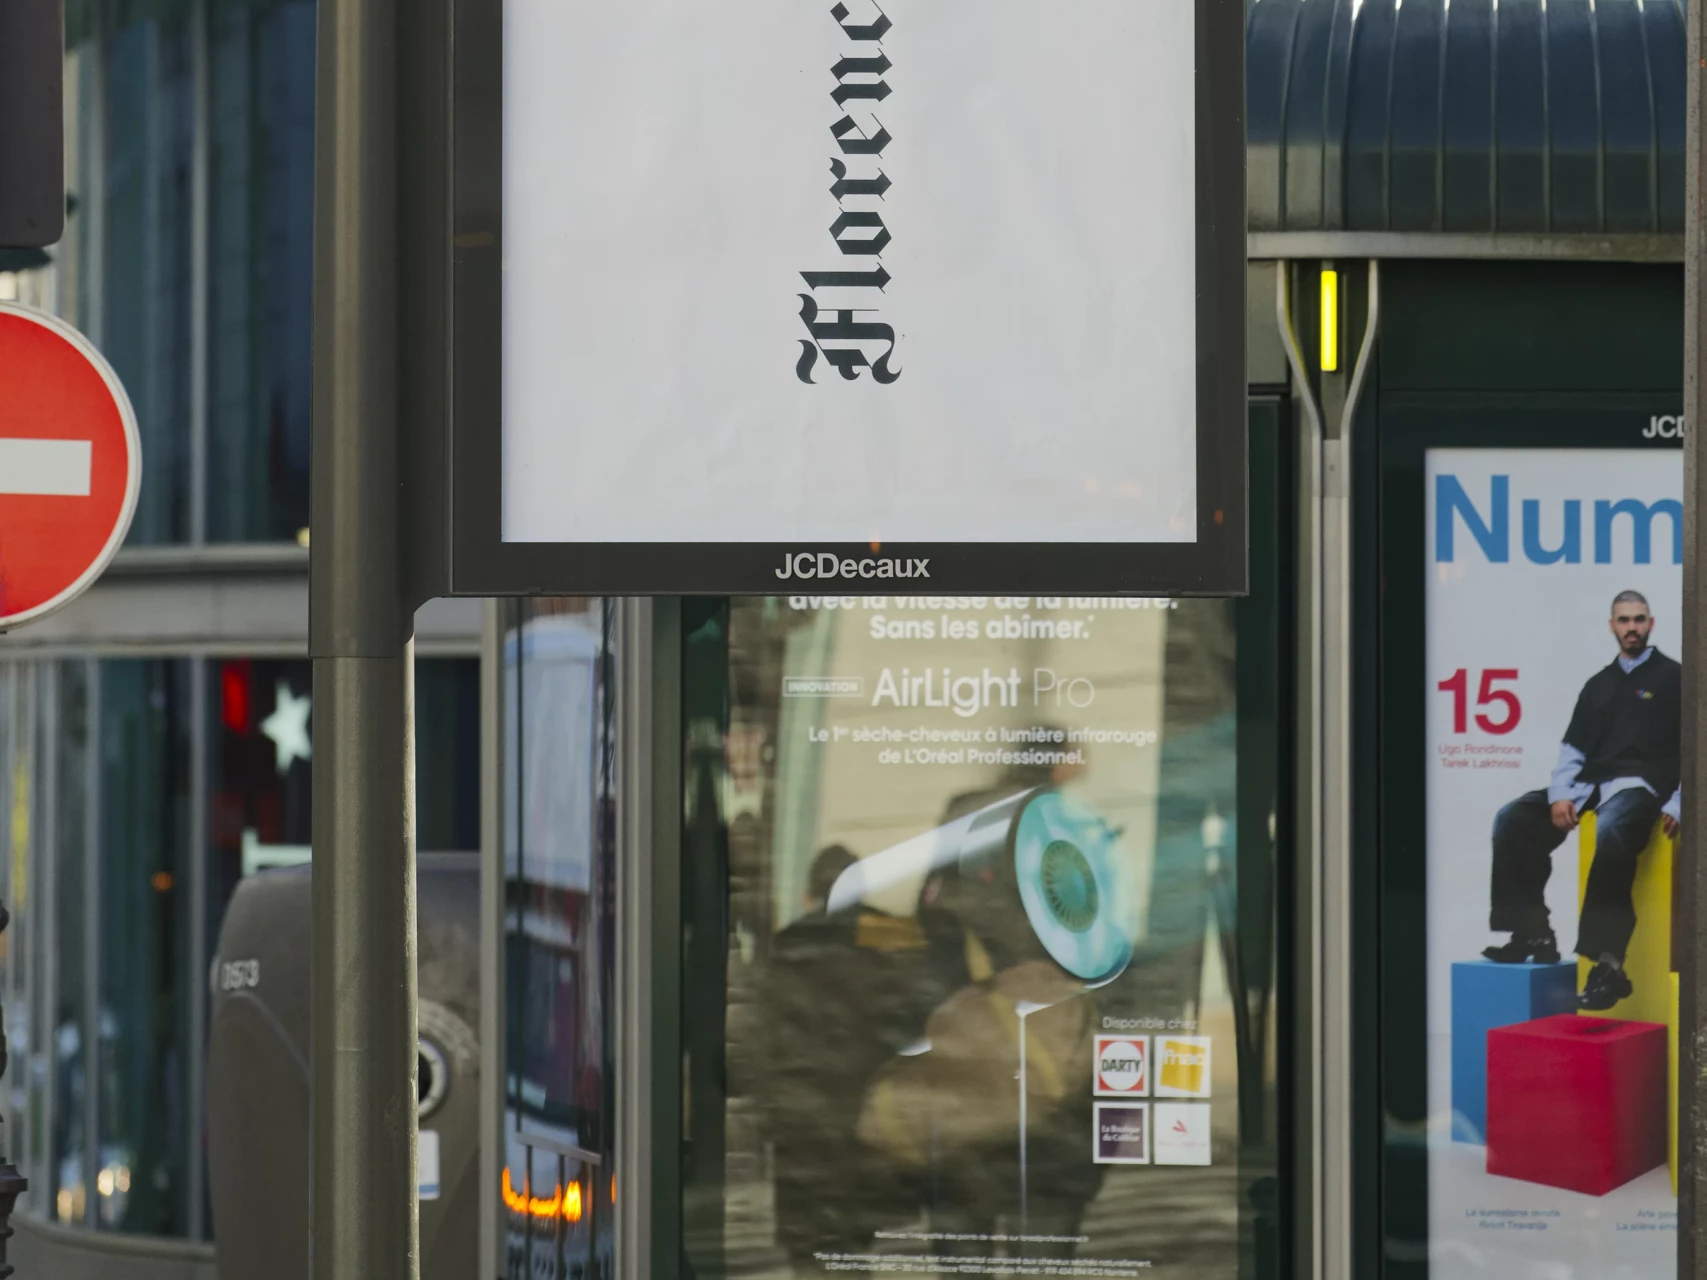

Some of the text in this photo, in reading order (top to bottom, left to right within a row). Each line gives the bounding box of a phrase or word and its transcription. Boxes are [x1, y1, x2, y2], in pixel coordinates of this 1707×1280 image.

[775, 553, 931, 579] JCDecaux
[870, 614, 936, 639] Sans
[941, 614, 980, 639] les
[871, 668, 1022, 717] AirLight
[1034, 668, 1095, 707] Pro
[1438, 668, 1522, 735] 15
[808, 726, 829, 742] Le
[852, 725, 982, 742] sèche-cheveux
[985, 727, 997, 742] à
[1000, 726, 1064, 743] lumière
[1067, 726, 1157, 747] infrarouge
[878, 748, 1085, 765] de L'Oréal Professionnel.
[1102, 1017, 1166, 1029] Disponible
[1101, 1059, 1141, 1072] DARTY
